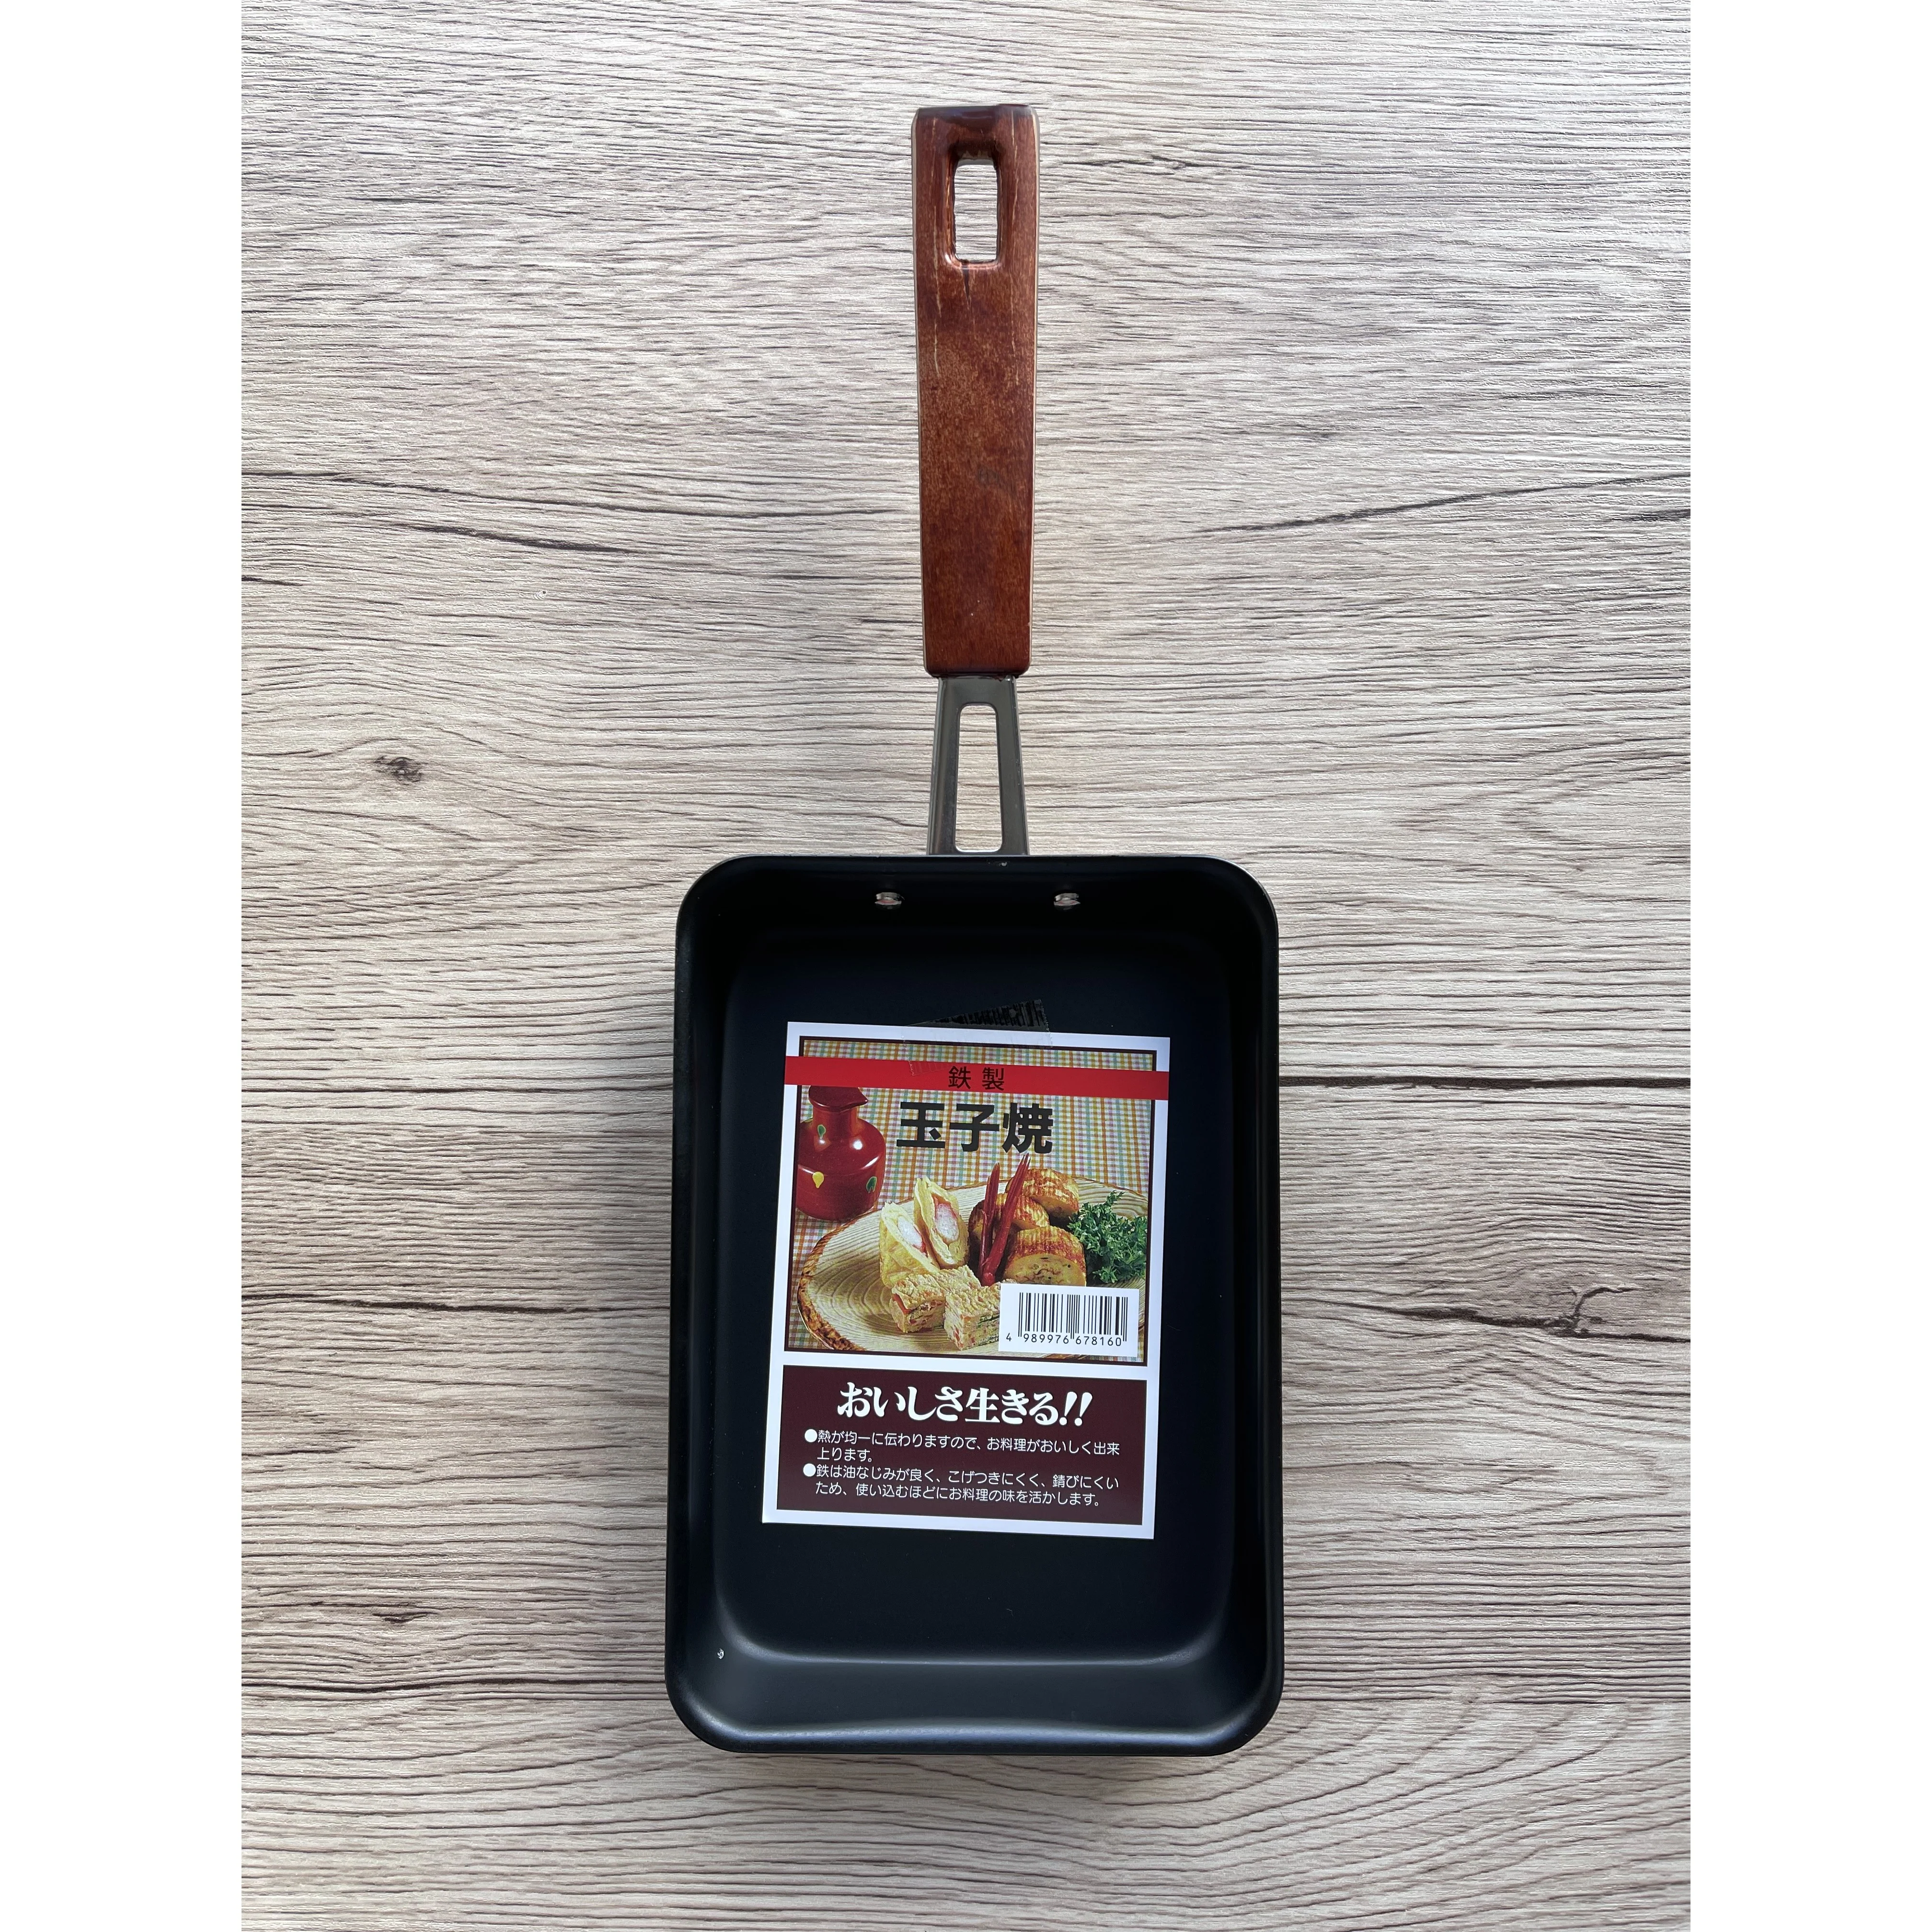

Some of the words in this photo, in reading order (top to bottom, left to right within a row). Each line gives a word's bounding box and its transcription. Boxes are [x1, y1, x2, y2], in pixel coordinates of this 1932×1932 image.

[948, 1065, 1005, 1091] 鉄製
[896, 1102, 1054, 1154] 玉子焼
[1023, 1333, 1069, 1344] 989976
[1075, 1336, 1122, 1346] 678160
[816, 1447, 873, 1462] 上ります。
